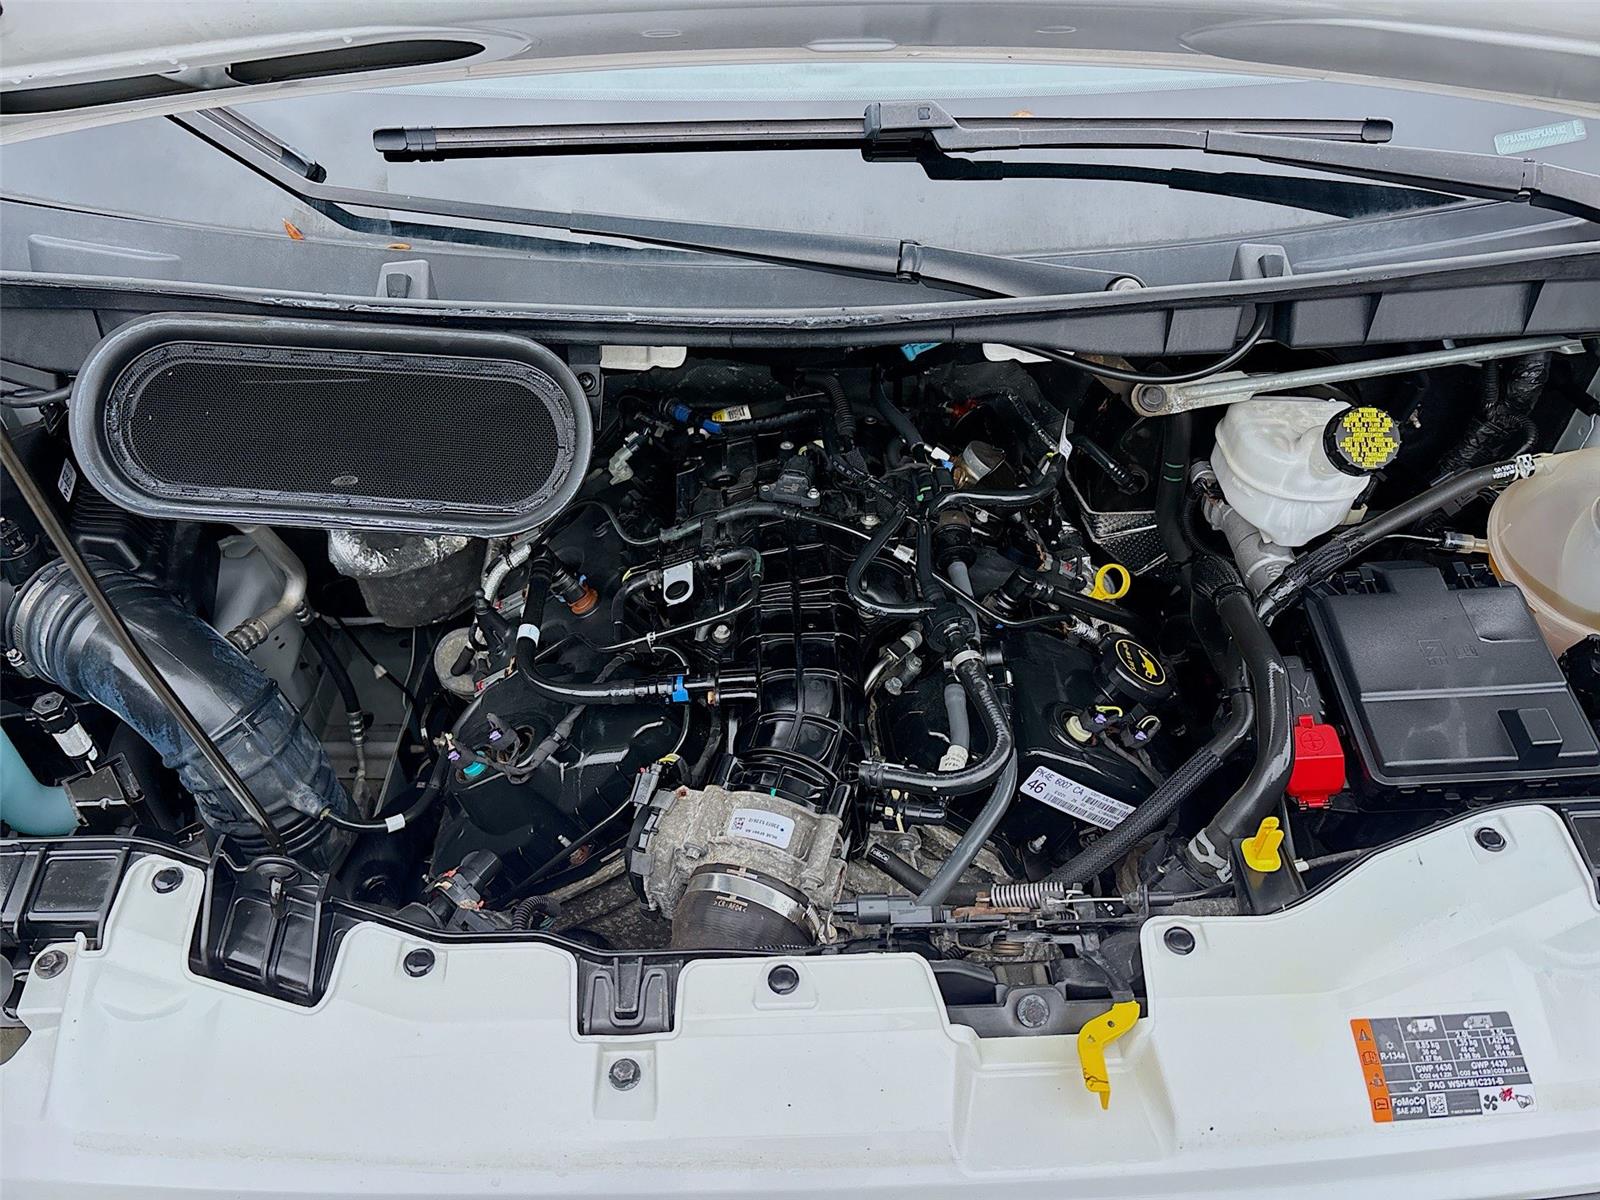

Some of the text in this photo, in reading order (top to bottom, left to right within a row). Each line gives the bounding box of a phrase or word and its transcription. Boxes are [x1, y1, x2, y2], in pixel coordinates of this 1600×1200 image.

[1027, 780, 1046, 793] 46
[1035, 768, 1084, 796] PK4E 6007 CA
[1469, 1038, 1478, 1047] kg
[1505, 1036, 1514, 1045] kg
[1431, 1041, 1440, 1050] kg
[1380, 1052, 1406, 1060] R-134a
[1428, 1081, 1445, 1090] PAG
[1392, 1097, 1425, 1107] FoMoCo
